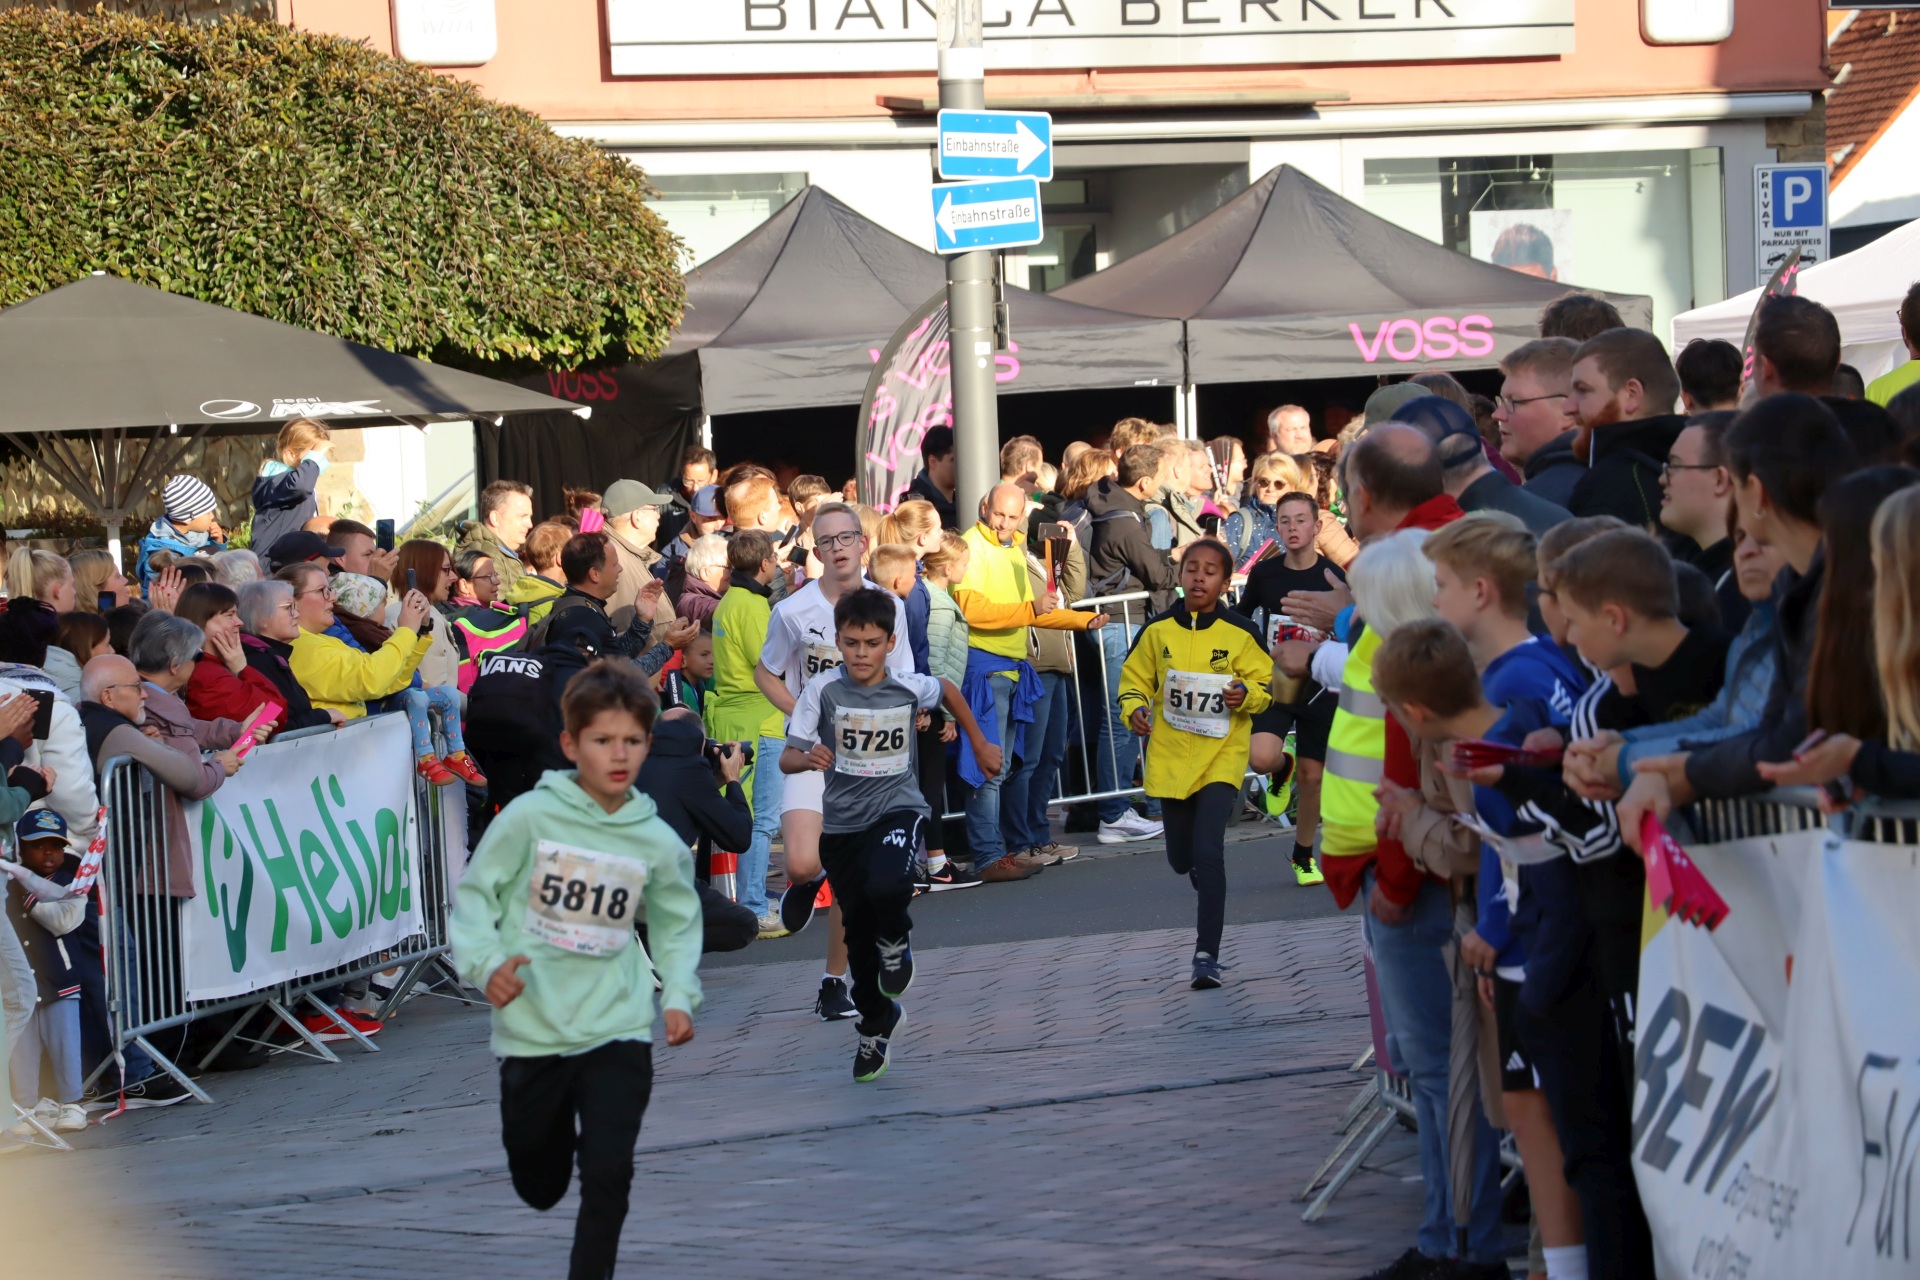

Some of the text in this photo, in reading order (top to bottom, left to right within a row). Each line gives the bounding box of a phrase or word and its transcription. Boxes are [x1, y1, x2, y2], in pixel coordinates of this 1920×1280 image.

[745, 0, 1076, 31] BIAA
[946, 137, 1019, 153] Einbahnstraße
[951, 204, 1031, 225] Einbahnstraße
[1761, 172, 1770, 229] PRIVAT
[1784, 176, 1812, 222] P
[1761, 237, 1822, 247] PARKAUSWEIS
[1774, 229, 1809, 238] NUR MIT
[1348, 314, 1495, 362] VOSS
[896, 340, 950, 391] VO
[547, 366, 619, 401] VOSS
[865, 390, 953, 472] VOS
[480, 656, 543, 679] VANS
[1169, 688, 1224, 714] 5173
[842, 727, 904, 751] 5726
[882, 833, 907, 848] PW
[239, 766, 411, 953] Helios
[540, 873, 629, 920] 5818
[1632, 986, 1782, 1195] BEW
